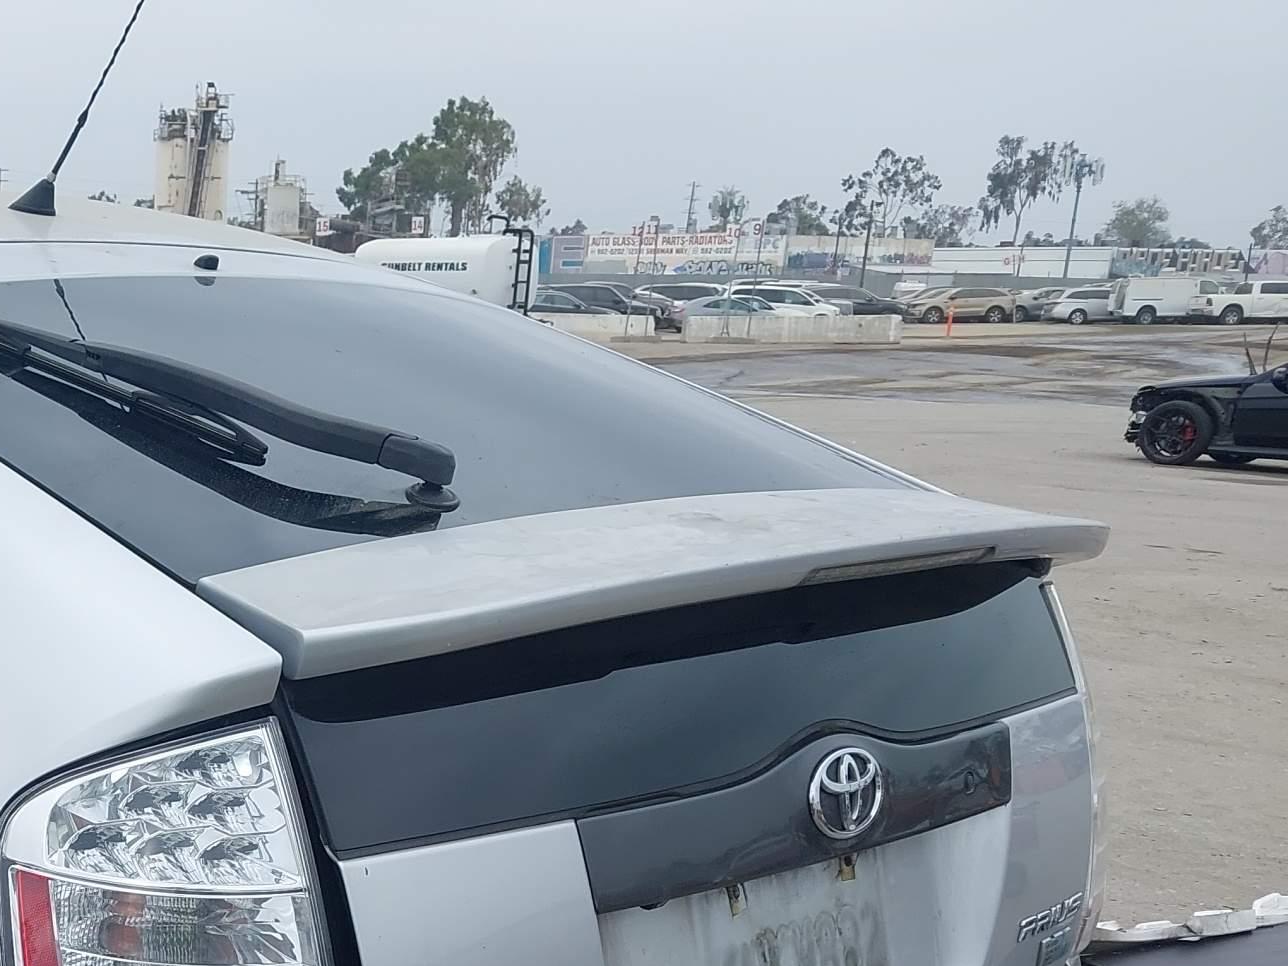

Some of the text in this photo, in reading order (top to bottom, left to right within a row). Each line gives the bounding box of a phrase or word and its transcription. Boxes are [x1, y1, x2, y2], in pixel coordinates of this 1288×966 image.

[317, 221, 329, 232] 15
[412, 220, 423, 231] 14
[753, 223, 762, 235] 9
[590, 237, 610, 246] AUTO
[424, 262, 468, 272] RENTALS
[1017, 892, 1084, 943] PRIUS
